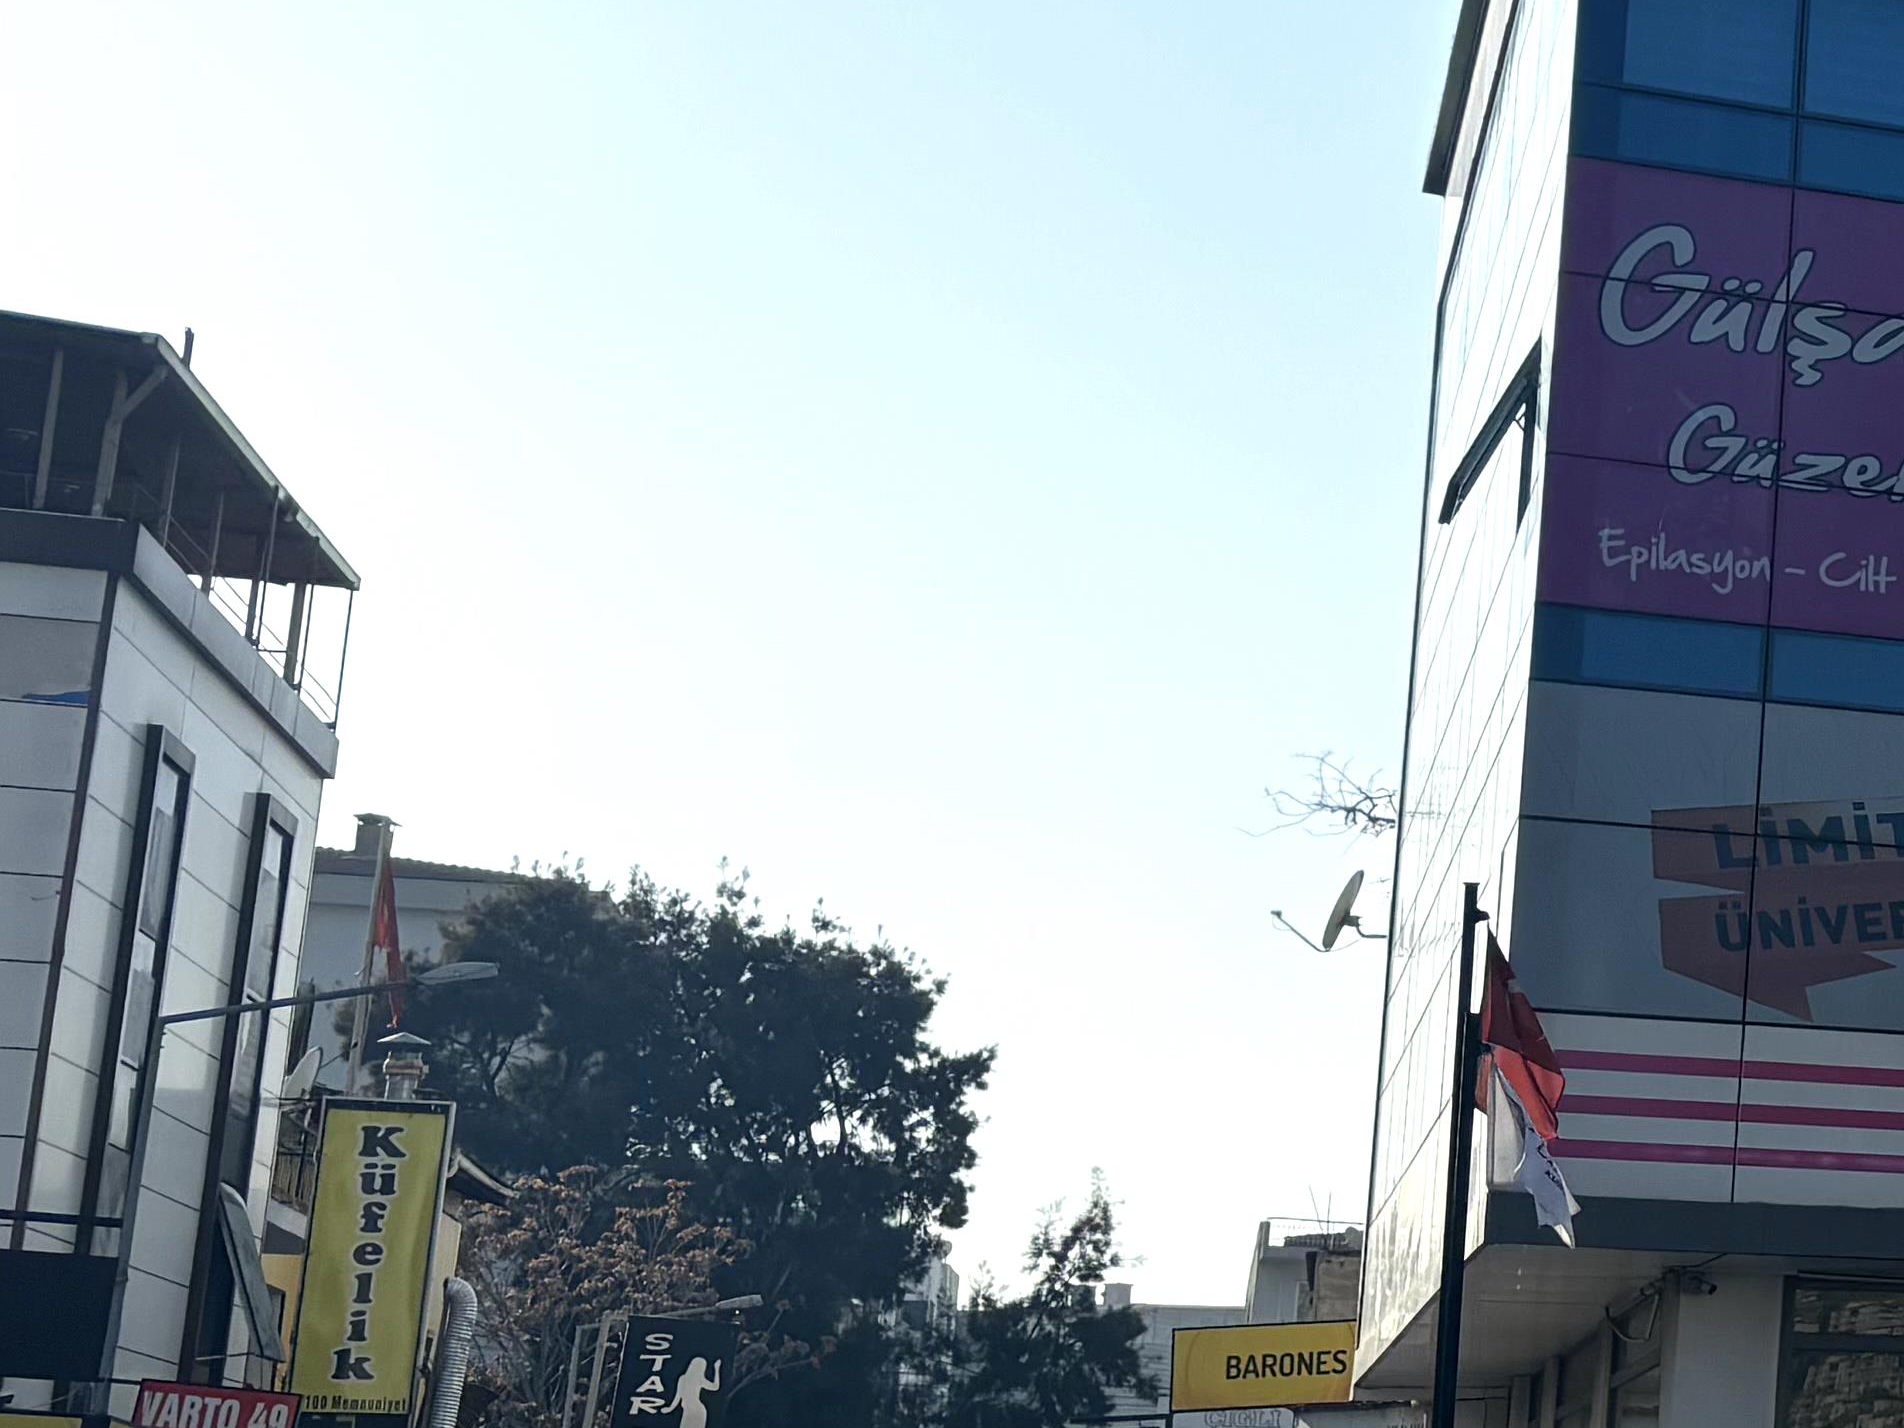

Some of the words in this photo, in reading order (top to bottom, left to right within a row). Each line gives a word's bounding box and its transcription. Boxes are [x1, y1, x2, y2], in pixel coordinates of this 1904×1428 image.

[1599, 529, 1770, 594] Epilasyon
[1820, 551, 1896, 589] Cilt
[331, 1126, 406, 1380] Küfelik
[629, 1333, 673, 1414] STAR
[1226, 1350, 1347, 1379] BARONES
